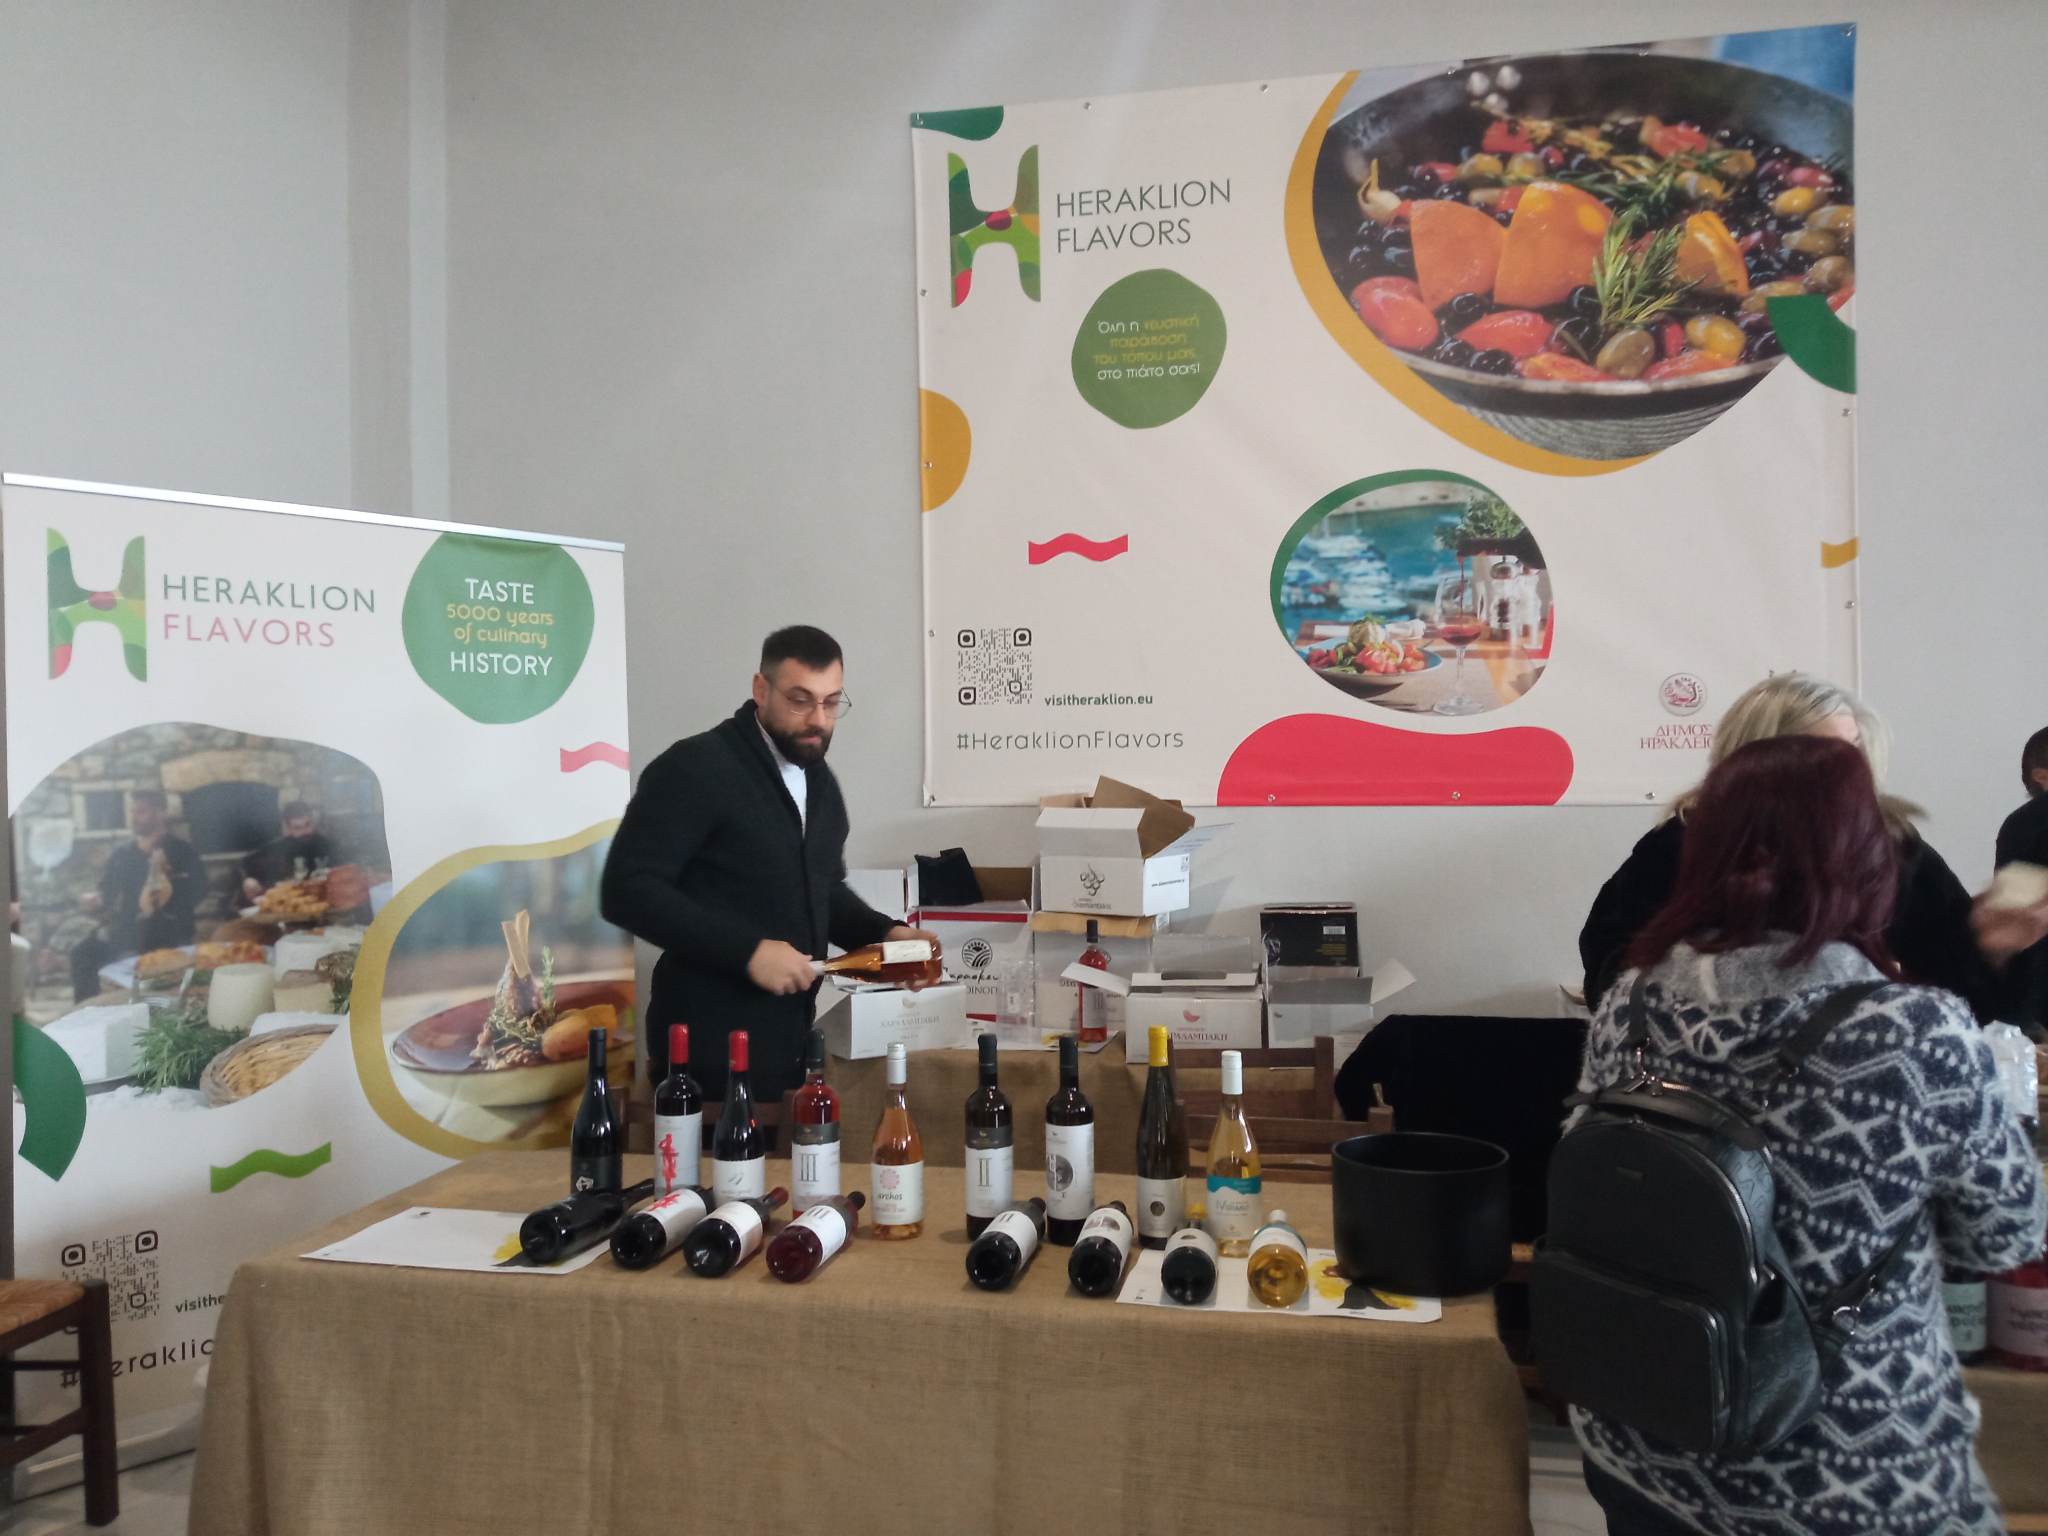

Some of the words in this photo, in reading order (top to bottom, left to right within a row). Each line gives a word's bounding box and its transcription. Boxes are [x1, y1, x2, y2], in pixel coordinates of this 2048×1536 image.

[1056, 178, 1232, 218] HERAKLION
[1056, 218, 1193, 254] FLAVORS
[1097, 368, 1122, 380] στο
[162, 573, 376, 614] HERAKLION
[464, 577, 535, 605] TASTE
[447, 603, 501, 622] 5000
[506, 611, 554, 628] years
[163, 613, 335, 648] FLAVORS
[454, 622, 473, 645] of
[477, 628, 548, 649] culinary
[450, 651, 553, 676] HISTORY
[1044, 693, 1154, 707] visitheraklion.eu
[956, 729, 1185, 751] #HeraklionFlavors
[1640, 736, 1712, 750] ΗΡΑΚΛΕΙ
[1656, 724, 1713, 737] ΔΗΜΟΣ
